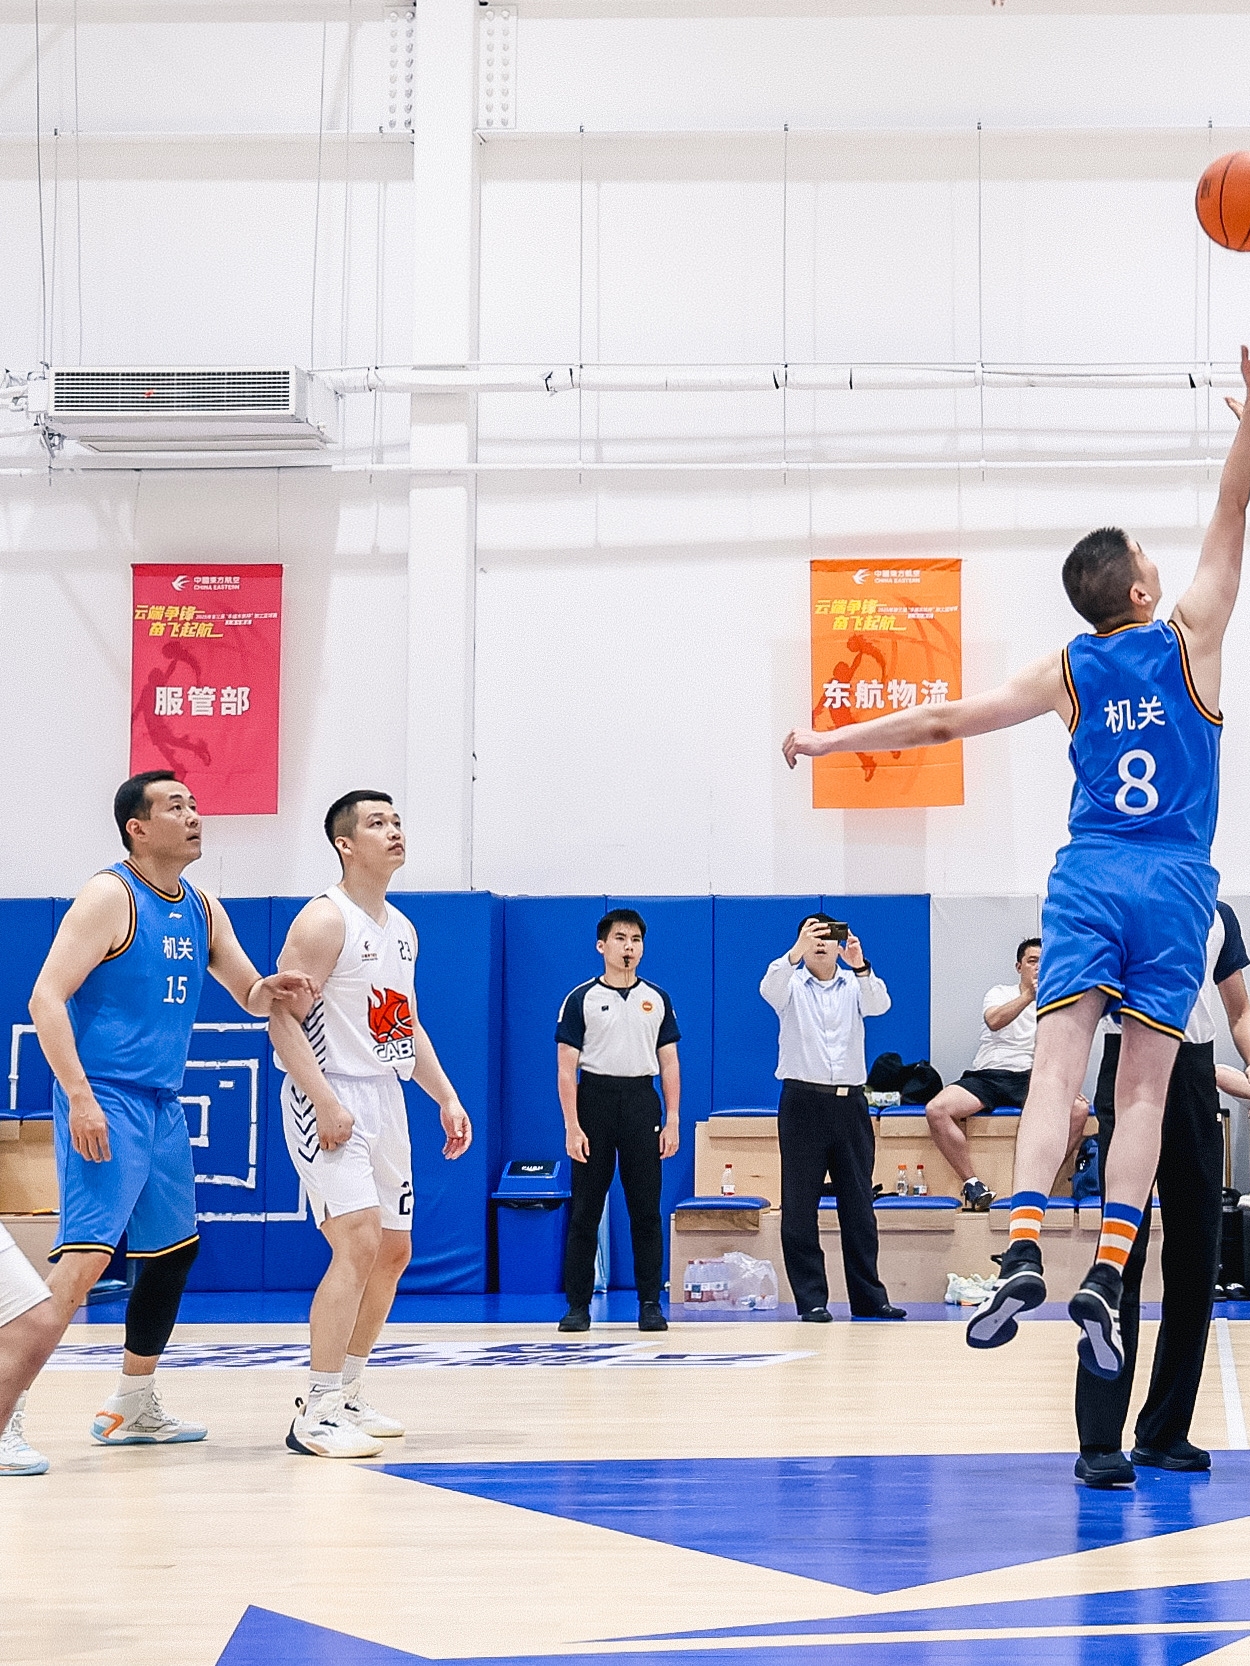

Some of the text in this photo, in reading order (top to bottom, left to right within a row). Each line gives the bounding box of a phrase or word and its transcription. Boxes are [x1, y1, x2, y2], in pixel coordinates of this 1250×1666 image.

[154, 686, 251, 716] 服管部
[822, 679, 949, 709] 东航物流
[1104, 695, 1166, 734] 机关
[1114, 748, 1159, 816] 8
[162, 935, 194, 961] 机关
[163, 975, 188, 1004] 15
